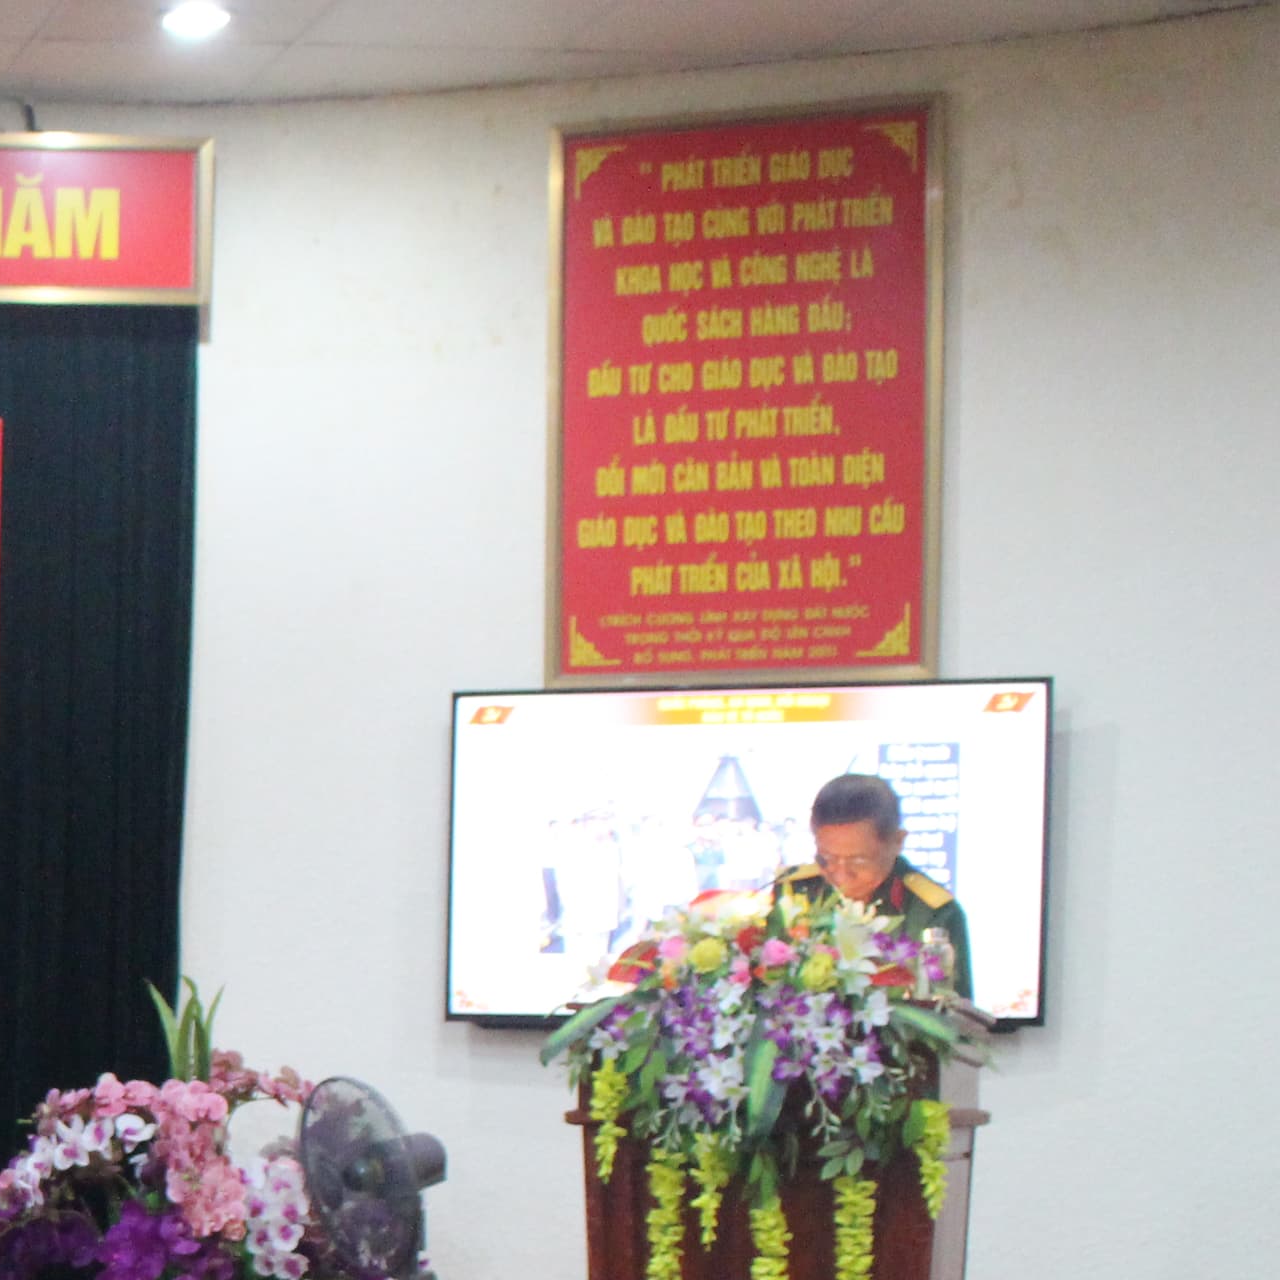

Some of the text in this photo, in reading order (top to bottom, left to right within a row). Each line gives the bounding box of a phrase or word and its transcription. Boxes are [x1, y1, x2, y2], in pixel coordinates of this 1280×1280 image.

[615, 245, 874, 296] KHOA HỌC VÀ CÔNG NGHỆ LÀ
[642, 305, 687, 346] QUỐC
[697, 302, 742, 340] SÁCH
[750, 300, 799, 335] HÀNG
[588, 358, 622, 398] ĐẦU
[629, 362, 652, 395] TƯ
[659, 361, 693, 392] CHO
[702, 354, 742, 390] GIÁO
[750, 356, 785, 393] DỤC
[793, 347, 814, 383] VÀ
[866, 349, 898, 384] TẠO
[633, 407, 655, 445] LÀ
[664, 404, 699, 443] ĐẦU
[706, 409, 729, 440] TƯ
[735, 402, 778, 438] PHÁT
[595, 454, 625, 497] ĐỔI
[632, 457, 666, 494] MỚI
[716, 450, 753, 490] BẢN
[760, 452, 781, 488] VÀ
[790, 449, 835, 486] TOÀN
[843, 446, 884, 489] DIỆN
[578, 510, 616, 549] GIÁO
[623, 515, 658, 549] DỤC
[666, 509, 687, 544] VÀ
[736, 510, 767, 545] TẠO
[774, 508, 817, 538] THEO
[824, 506, 861, 536] NHU
[869, 497, 905, 535] CẦU
[631, 560, 673, 596] PHÁT
[679, 551, 728, 595] TRIỂN
[736, 551, 771, 591] CỦA
[779, 555, 802, 589] XÃ
